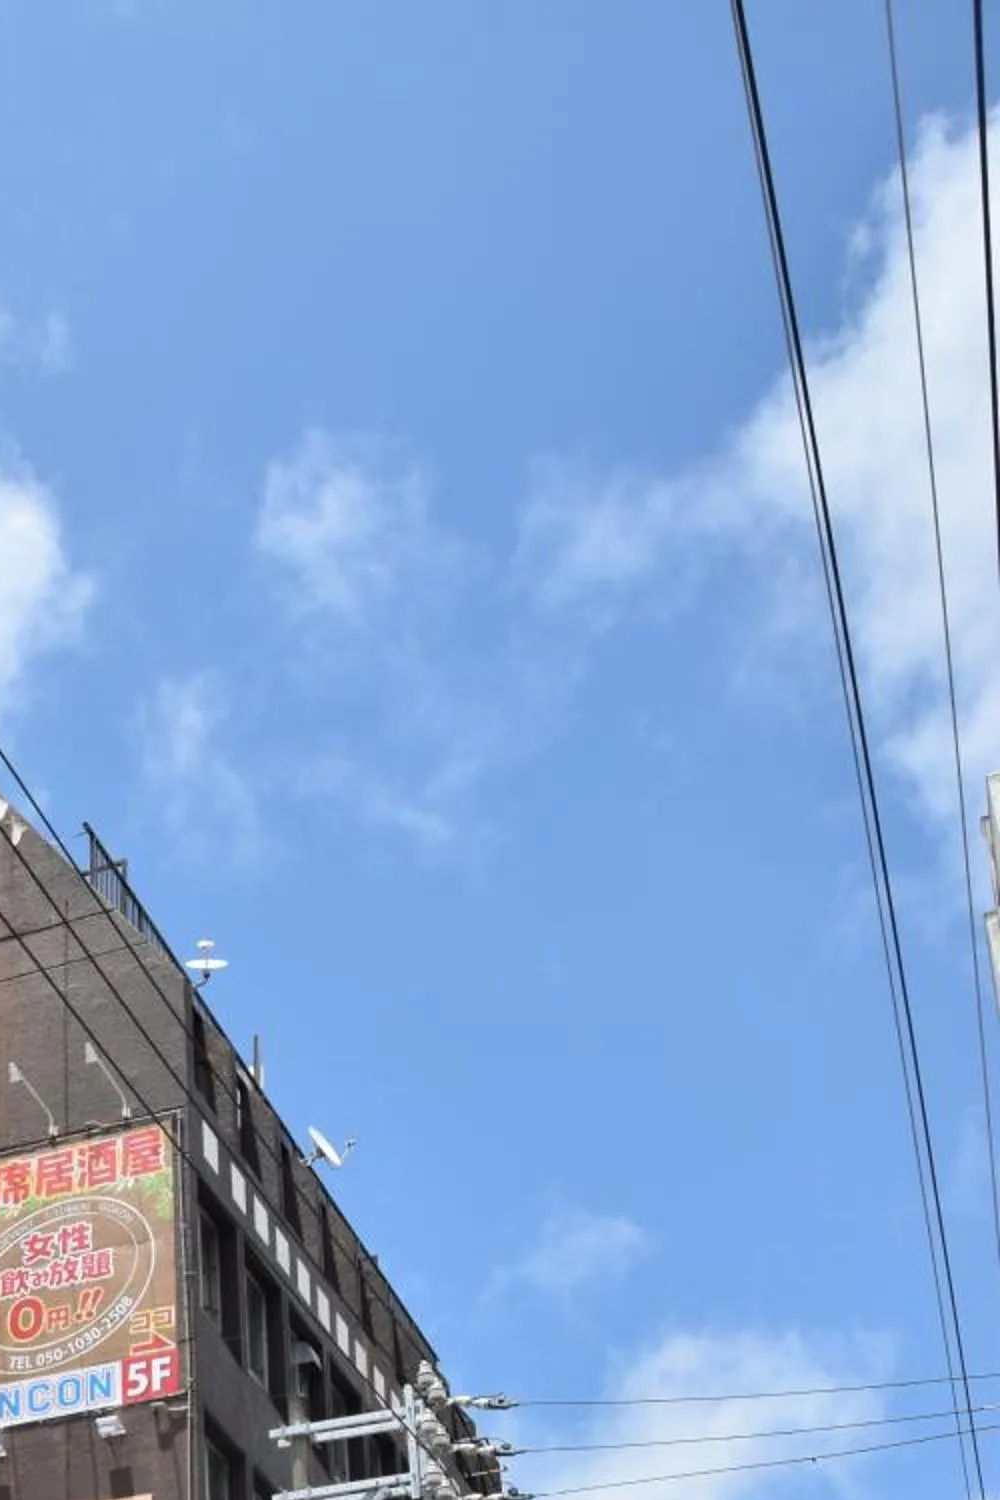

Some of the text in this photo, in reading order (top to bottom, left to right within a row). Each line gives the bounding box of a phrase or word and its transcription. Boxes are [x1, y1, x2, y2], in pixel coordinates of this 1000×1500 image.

[22, 1220, 93, 1265] 女性
[8, 1354, 33, 1370] TEL
[125, 1355, 172, 1397] 5F
